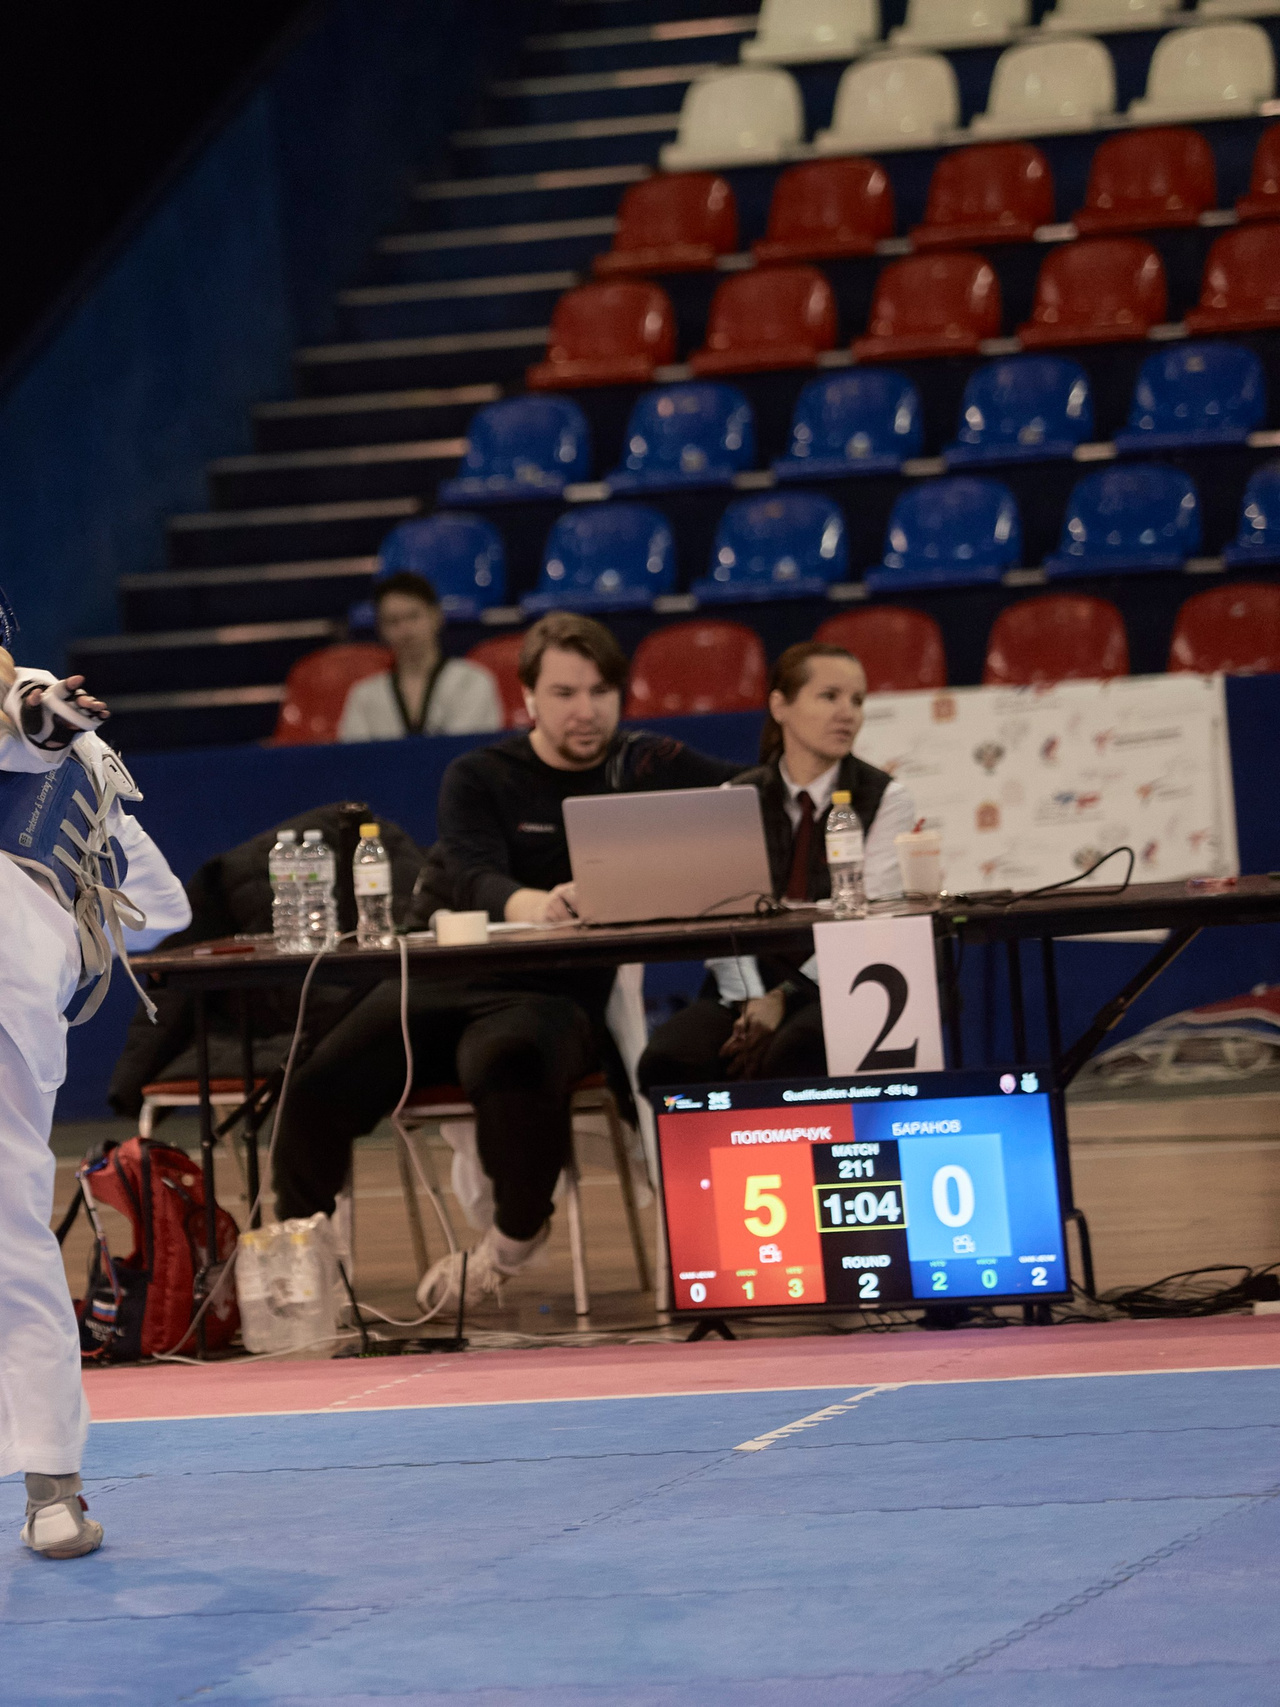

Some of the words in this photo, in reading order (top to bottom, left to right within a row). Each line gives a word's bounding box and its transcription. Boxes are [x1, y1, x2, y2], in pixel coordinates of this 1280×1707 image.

[848, 963, 918, 1071] 2
[782, 1086, 848, 1101] Qualification
[848, 1085, 882, 1098] Junior
[902, 1084, 918, 1097] kg
[892, 1119, 962, 1136] БАРАНОВ
[831, 1143, 880, 1157] MATCH
[838, 1159, 874, 1178] 211
[743, 1174, 787, 1238] 5
[932, 1165, 975, 1228] 0
[823, 1191, 901, 1225] 1:04
[842, 1255, 891, 1269] ROUND
[858, 1273, 880, 1298] 2
[931, 1271, 949, 1291] 2
[981, 1269, 998, 1289] 0
[1031, 1267, 1048, 1286] 2
[690, 1283, 707, 1303] 0
[742, 1280, 755, 1300] 1
[788, 1278, 805, 1298] 3
